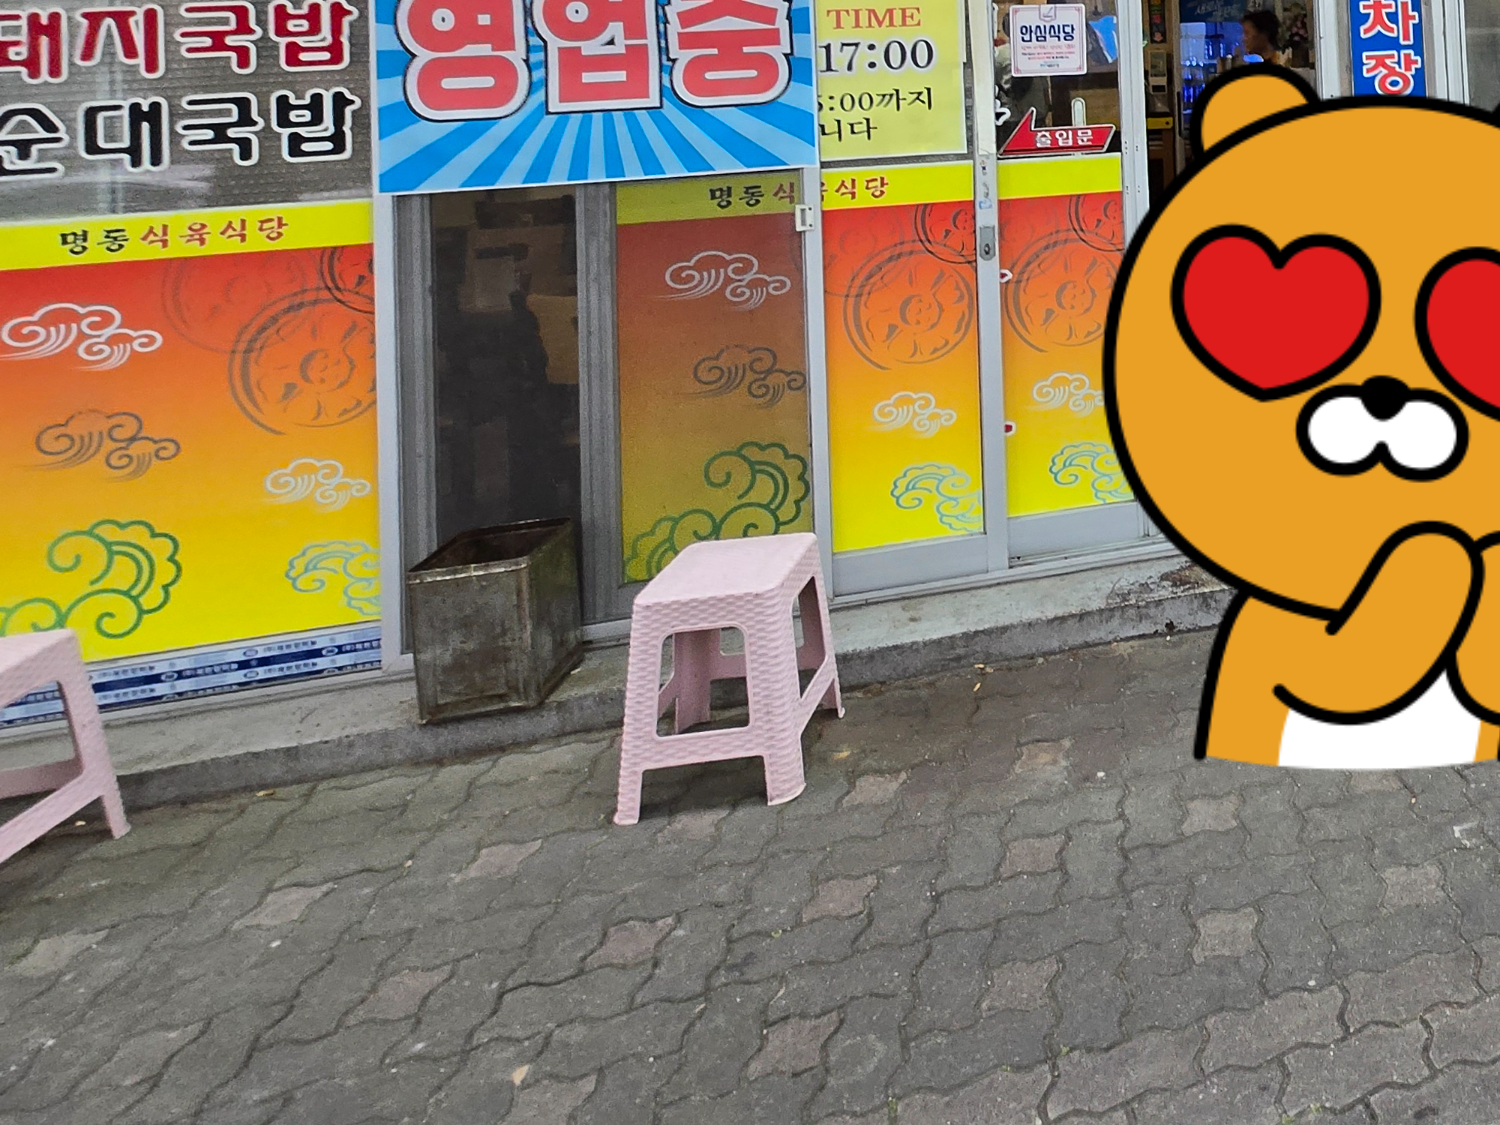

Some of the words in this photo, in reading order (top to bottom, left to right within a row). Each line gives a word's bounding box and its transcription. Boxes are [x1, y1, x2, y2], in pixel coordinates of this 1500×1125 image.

[826, 6, 922, 30] TIME
[1020, 23, 1076, 43] 안심식당
[818, 38, 934, 73] 17:00
[0, 86, 362, 177] 순대국밥
[1034, 129, 1094, 149] 출입문
